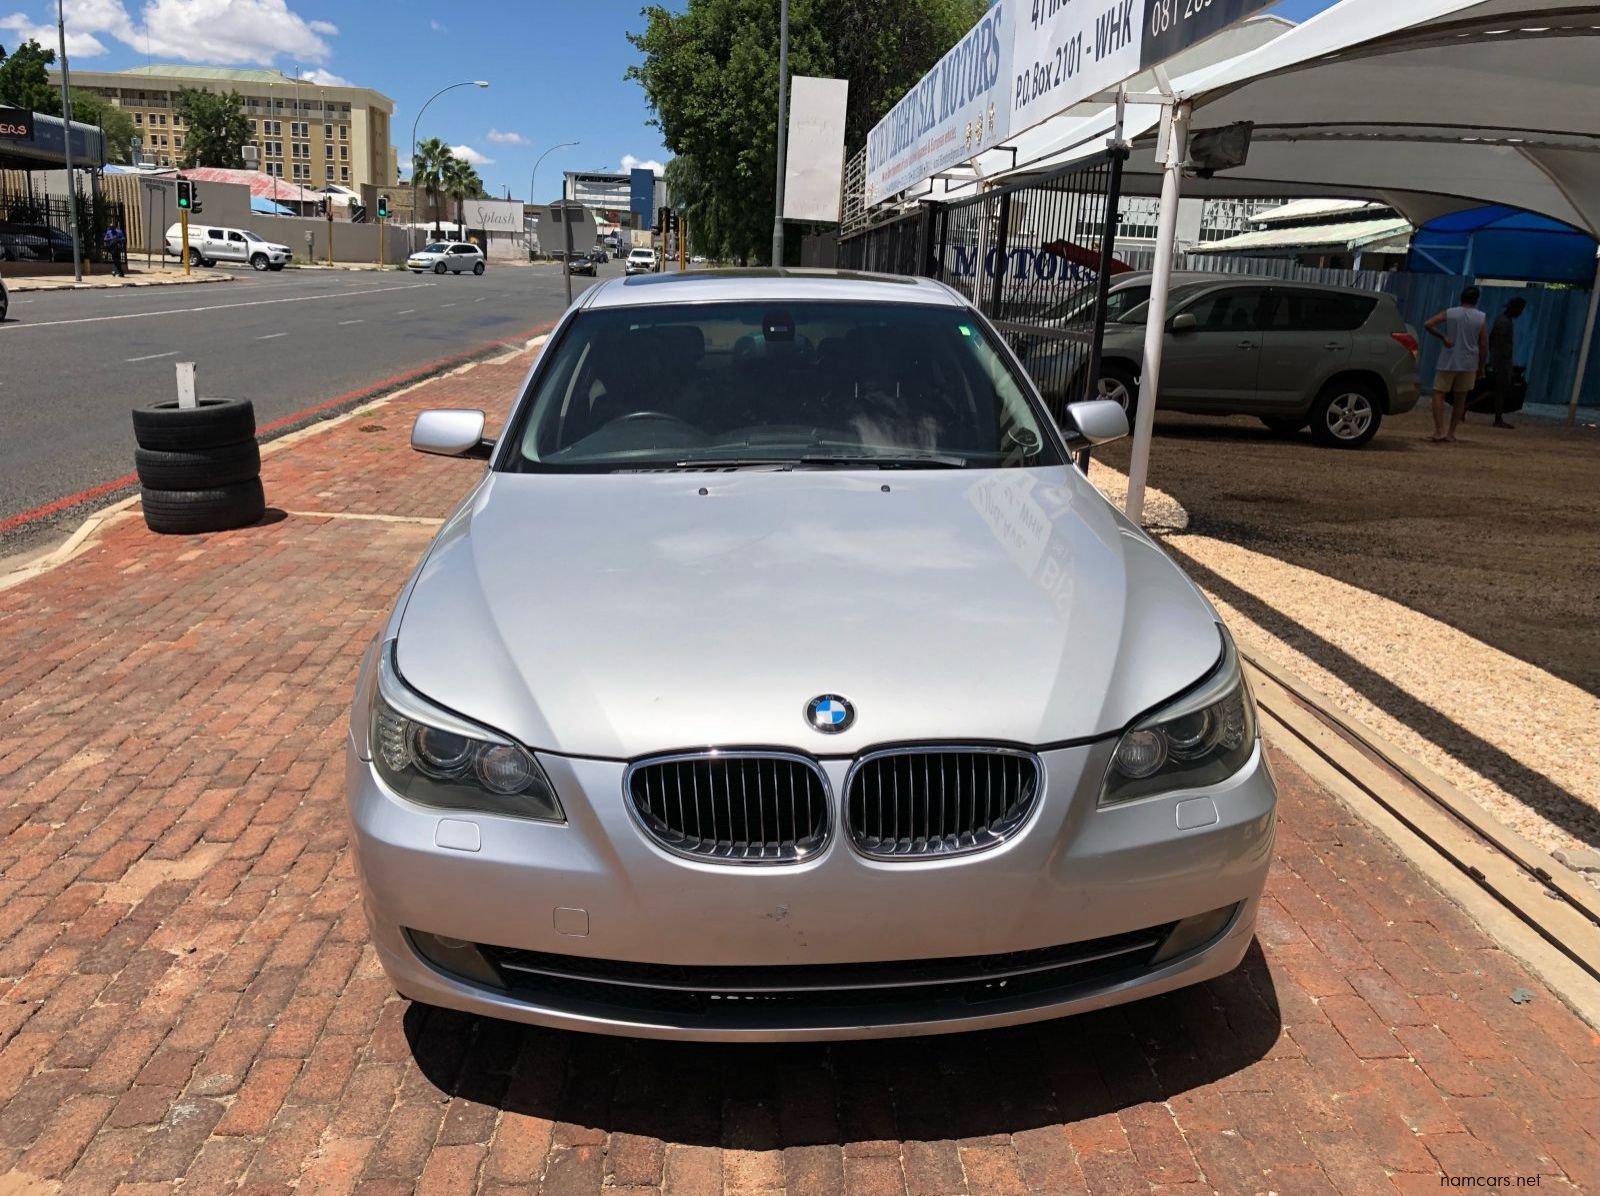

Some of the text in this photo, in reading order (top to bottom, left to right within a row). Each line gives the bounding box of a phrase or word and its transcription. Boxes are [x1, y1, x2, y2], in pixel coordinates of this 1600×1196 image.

[890, 88, 918, 158] EIGHT
[918, 68, 939, 138] SIX
[939, 4, 1002, 124] MOTORS
[1032, 61, 1053, 101] Box
[1053, 30, 1082, 87] 2101
[1095, 0, 1133, 62] WHK
[476, 206, 515, 228] Splash
[811, 695, 850, 706] BMW
